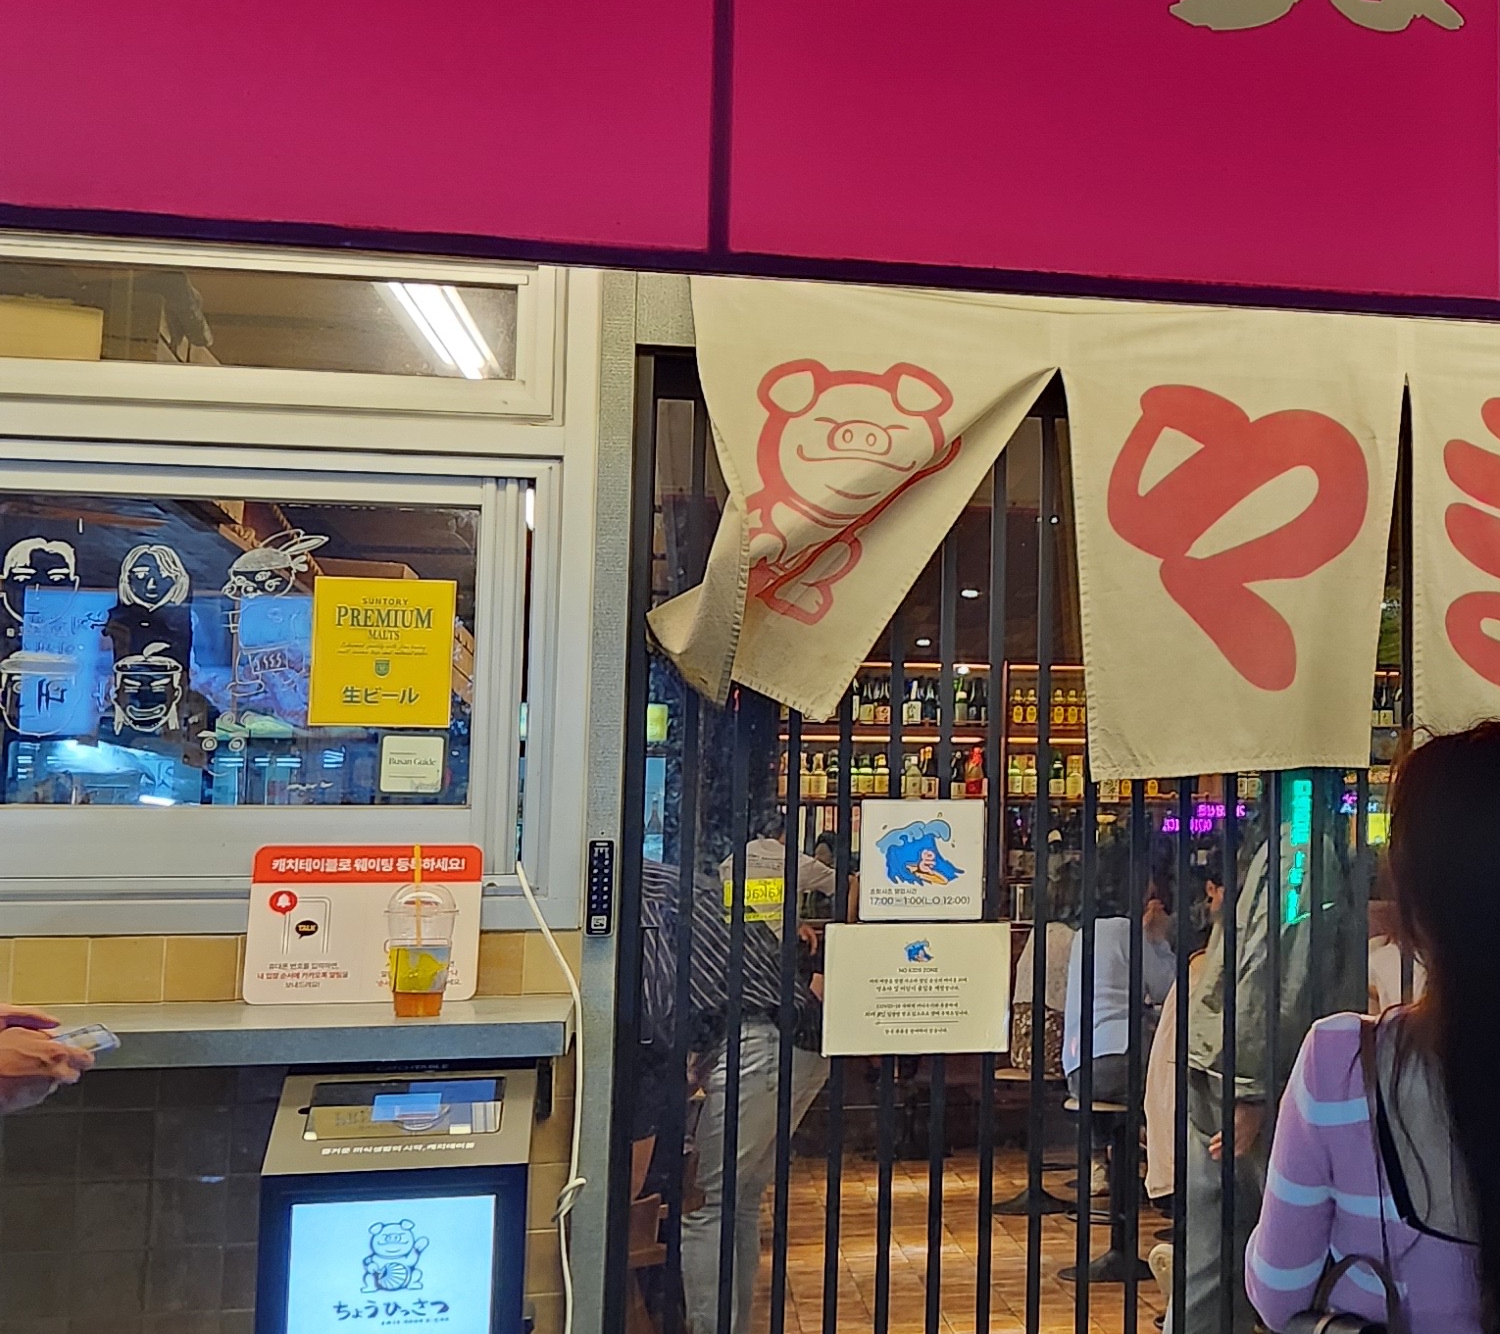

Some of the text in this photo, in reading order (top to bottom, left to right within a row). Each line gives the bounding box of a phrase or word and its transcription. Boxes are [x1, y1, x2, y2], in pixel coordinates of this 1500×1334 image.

[336, 606, 433, 629] PREMIUM
[368, 630, 400, 640] MALTS
[342, 686, 419, 704] 生ビール
[388, 757, 412, 765] Busan
[271, 857, 352, 873] 캐치테이블로
[353, 857, 393, 872] 웨이팅
[869, 896, 894, 906] 17:00
[332, 1297, 450, 1321] ちょうひっさつ
